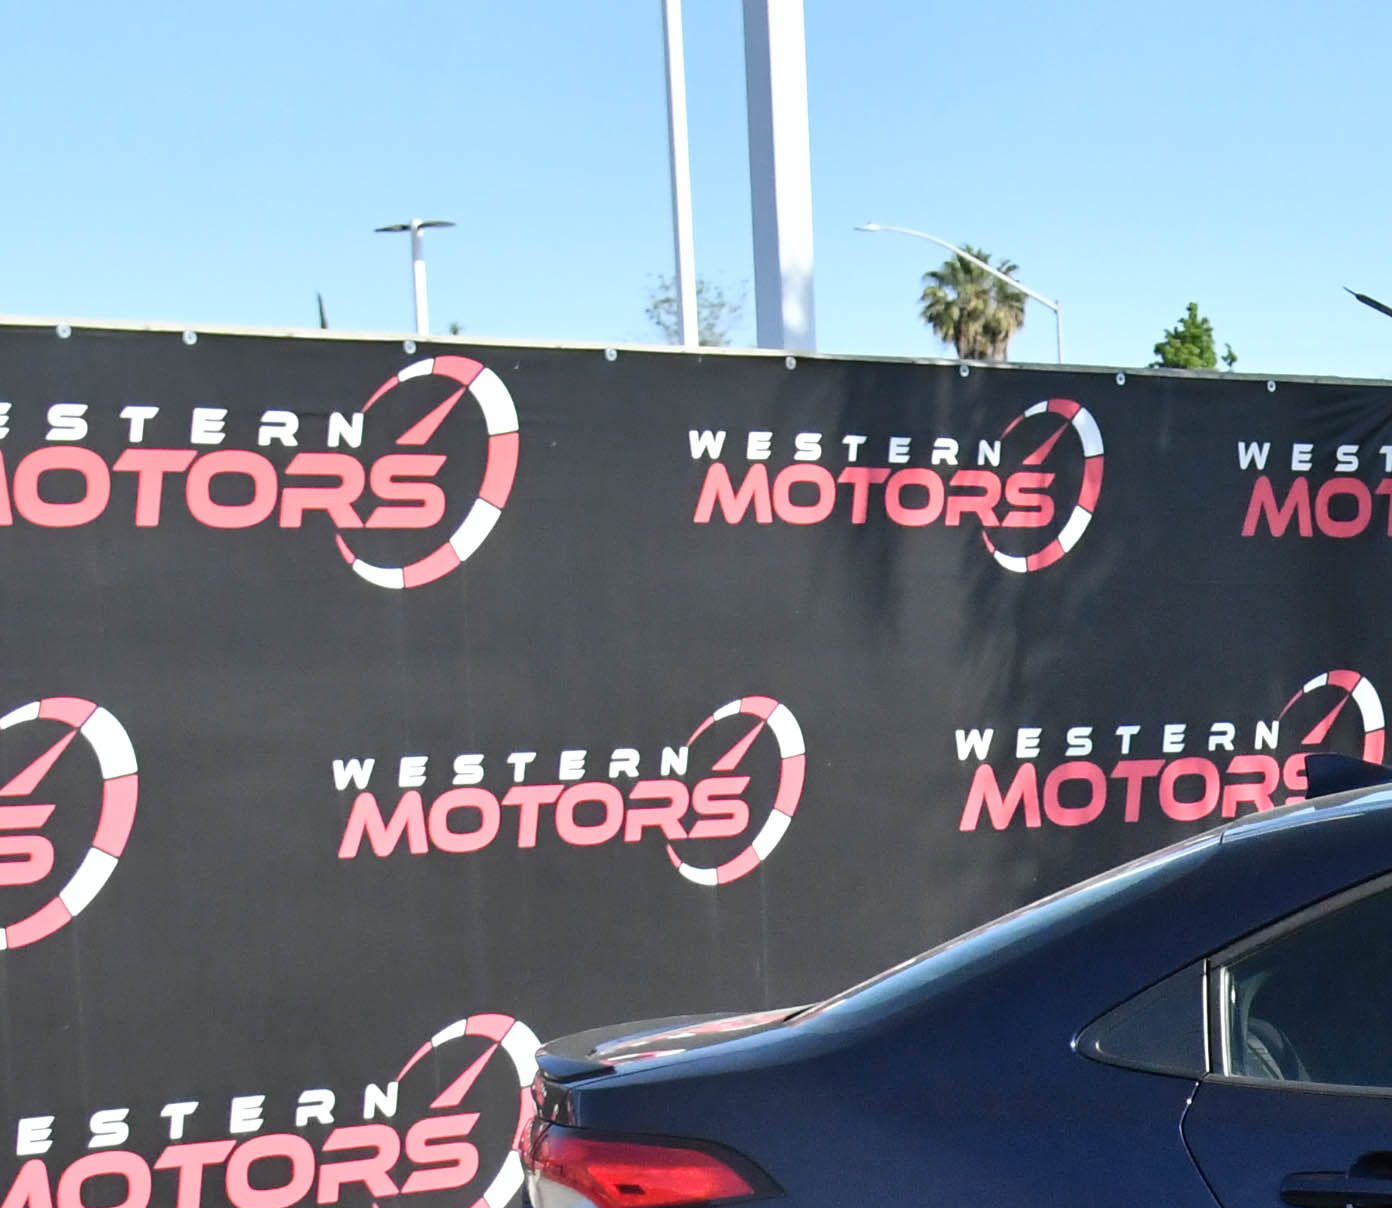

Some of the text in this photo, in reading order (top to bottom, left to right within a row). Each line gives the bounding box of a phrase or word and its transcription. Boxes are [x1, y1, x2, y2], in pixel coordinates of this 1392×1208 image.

[688, 430, 1001, 466] WESTERN
[0, 445, 448, 530] OTORS
[692, 462, 1056, 528] MOTORS
[955, 720, 1280, 760] WESTERN
[332, 746, 689, 790] WESTERN
[337, 776, 751, 859] MOTORS
